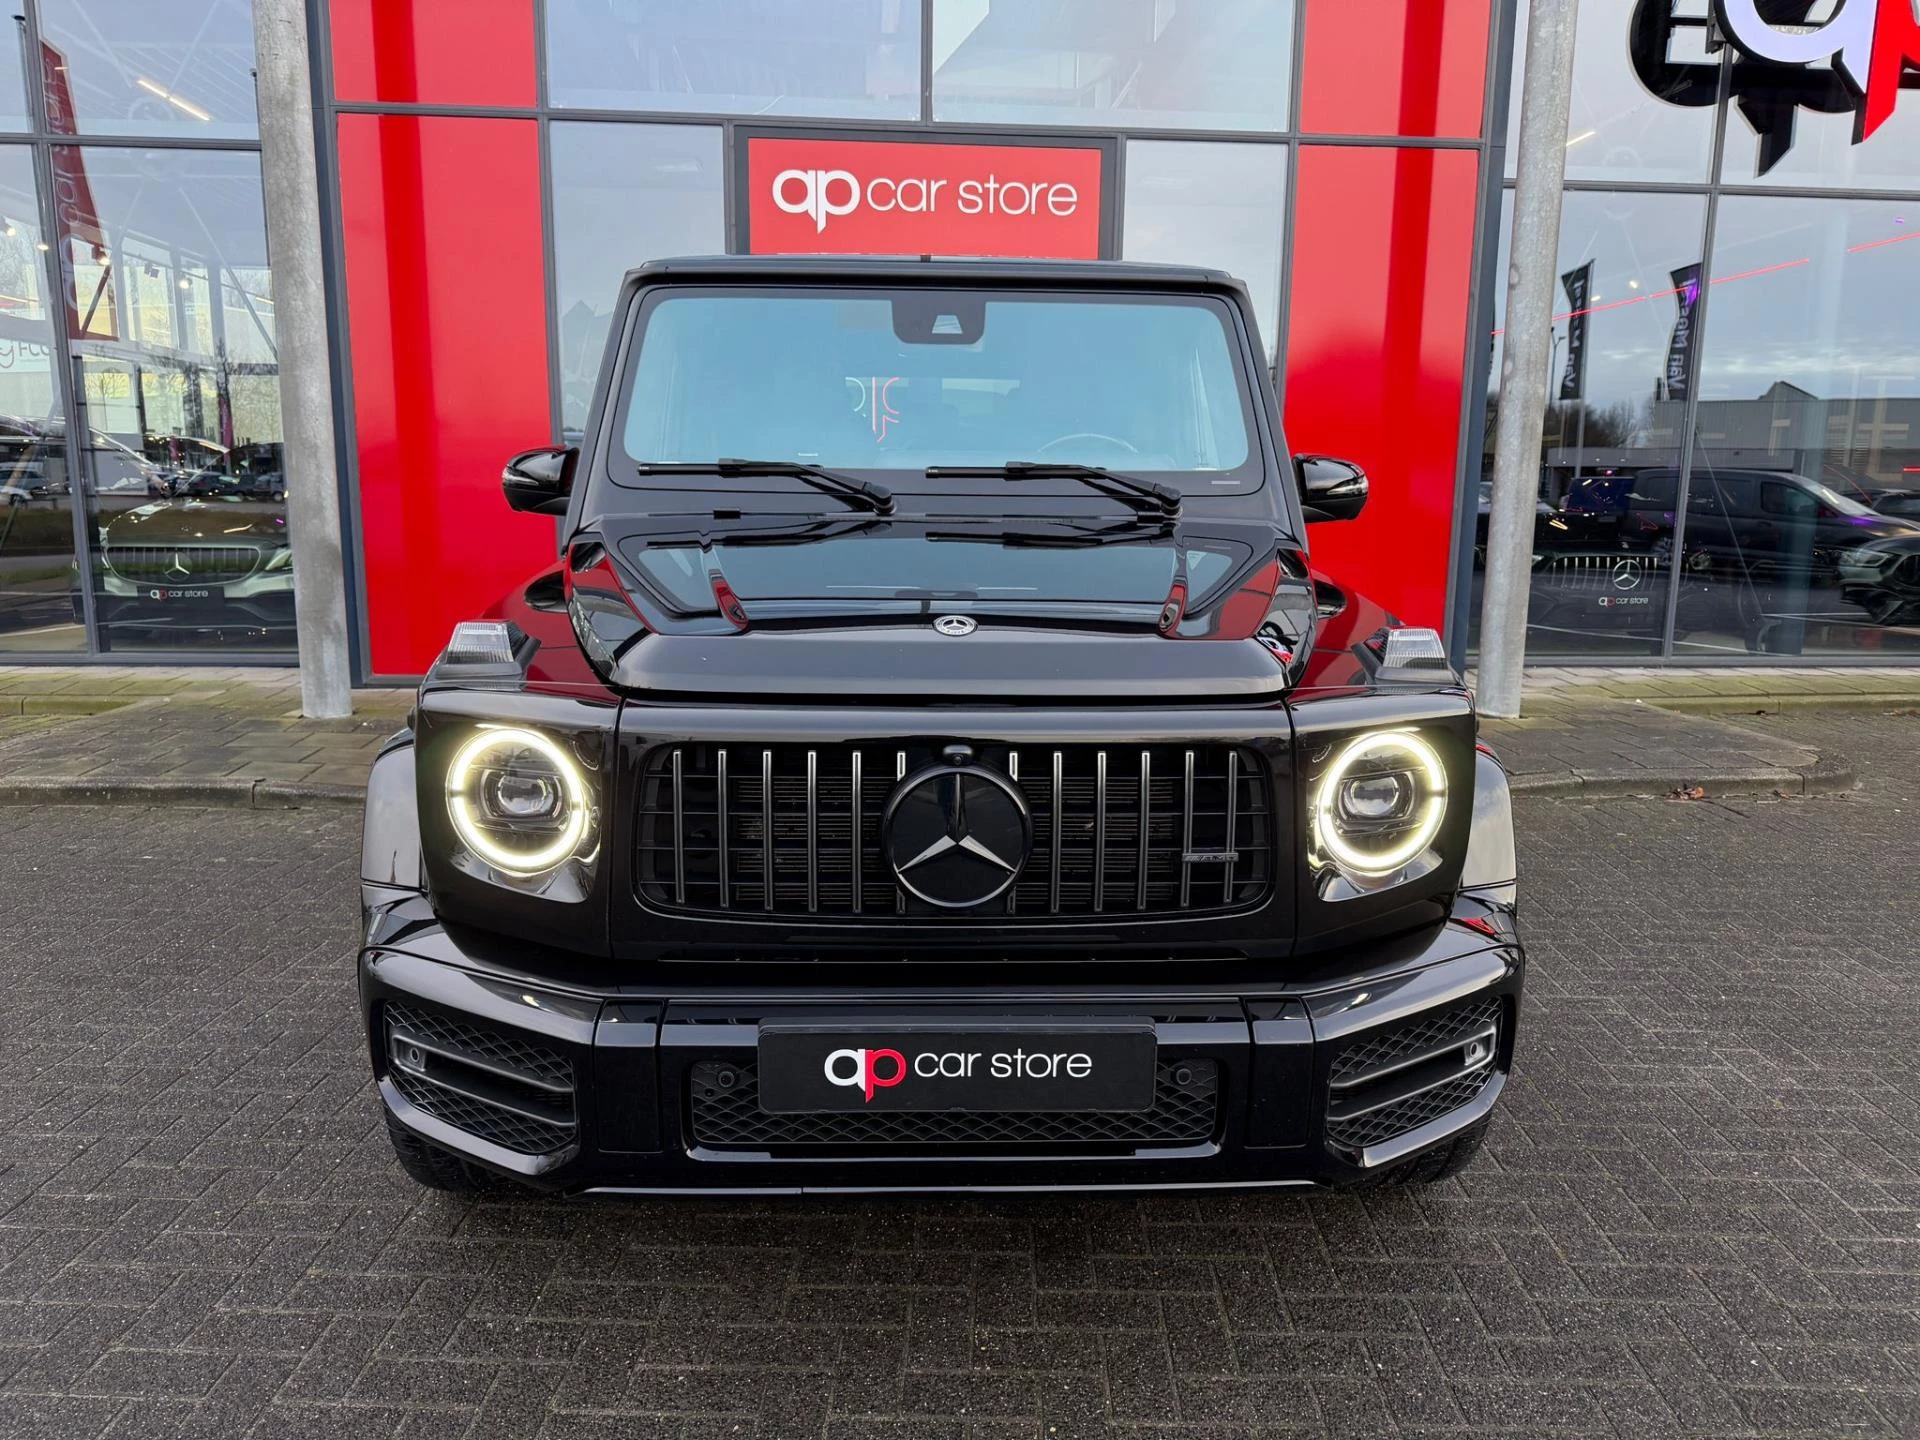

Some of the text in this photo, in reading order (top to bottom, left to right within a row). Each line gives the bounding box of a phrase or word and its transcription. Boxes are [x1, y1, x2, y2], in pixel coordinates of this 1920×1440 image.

[772, 169, 1078, 234] ap car store
[1630, 596, 1648, 604] store
[824, 1048, 1092, 1103] ap car store
